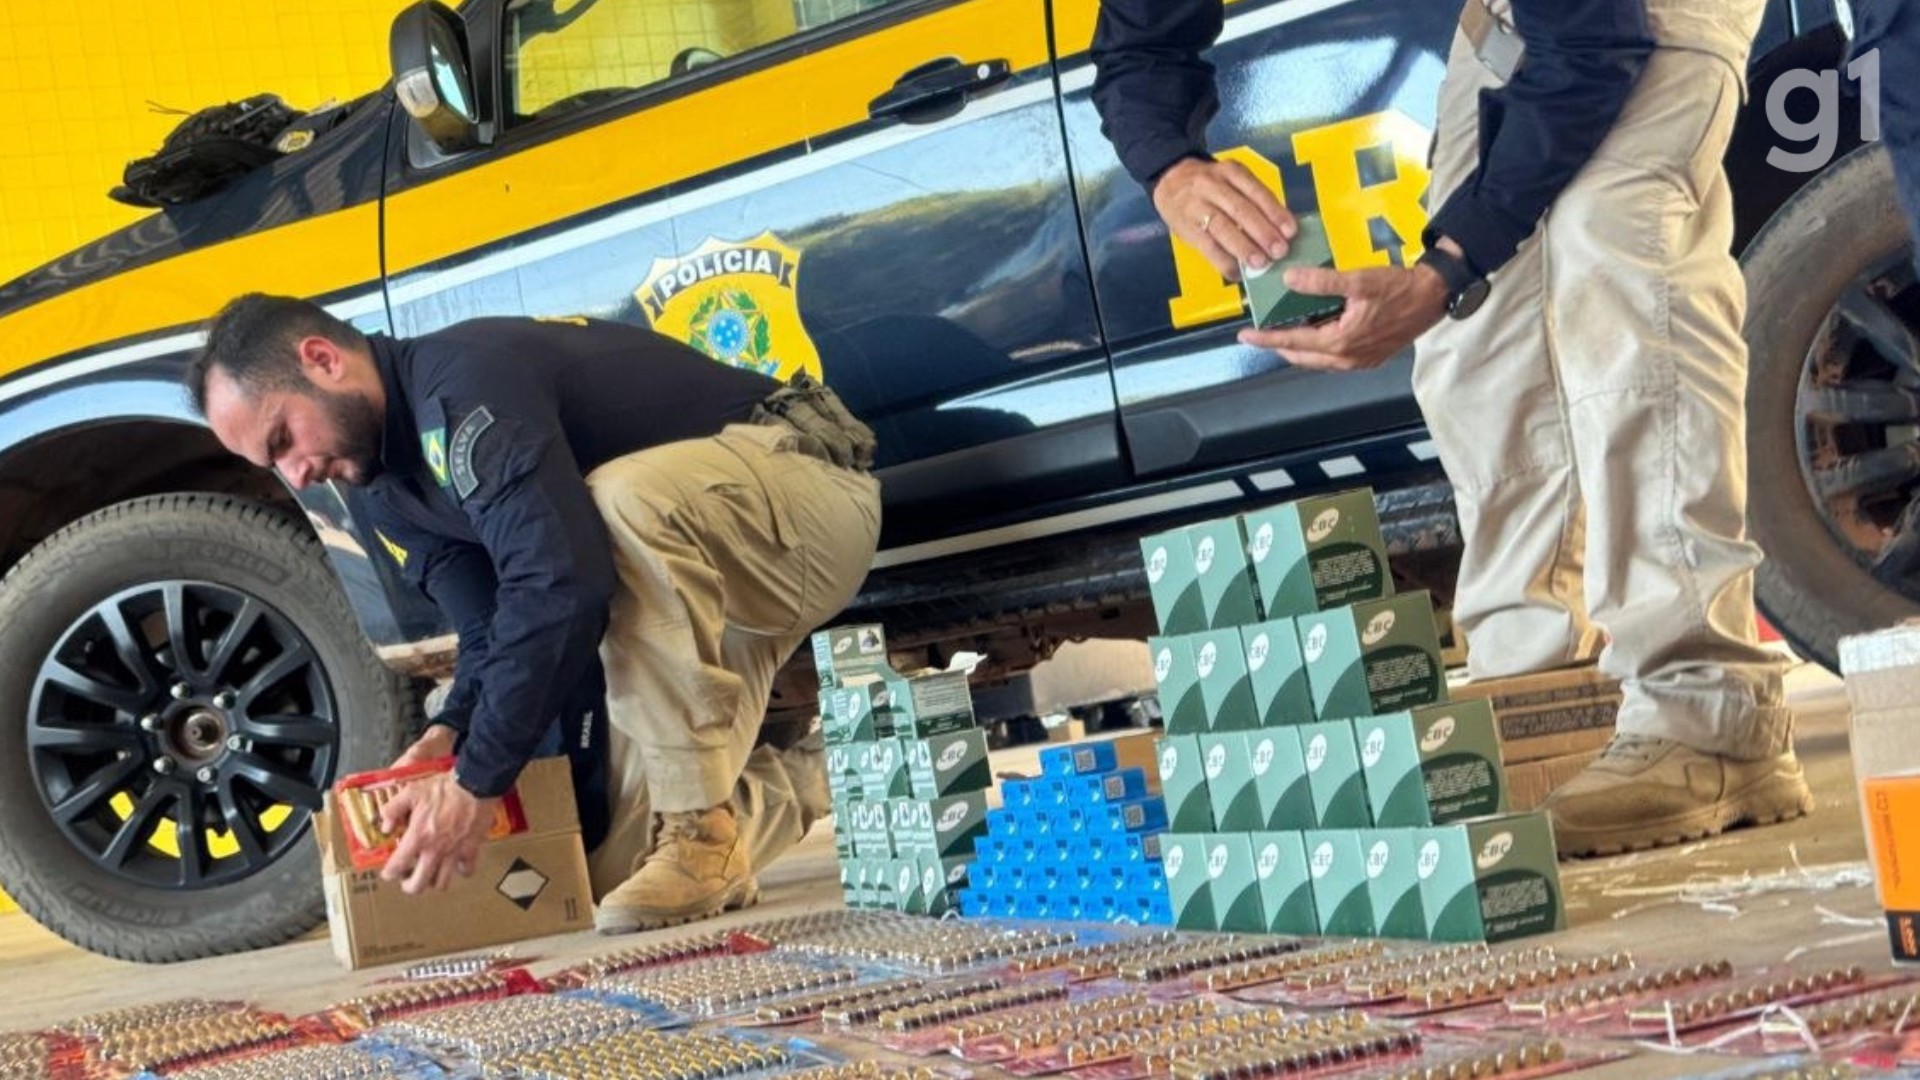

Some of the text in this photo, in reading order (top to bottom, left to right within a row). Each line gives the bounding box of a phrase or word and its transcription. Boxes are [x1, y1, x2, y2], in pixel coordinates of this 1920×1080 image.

[455, 424, 476, 476] SELVA
[1309, 515, 1338, 534] CBC
[1364, 619, 1394, 635] CBC
[1422, 726, 1454, 742] CBC
[1479, 841, 1513, 858] CBC
